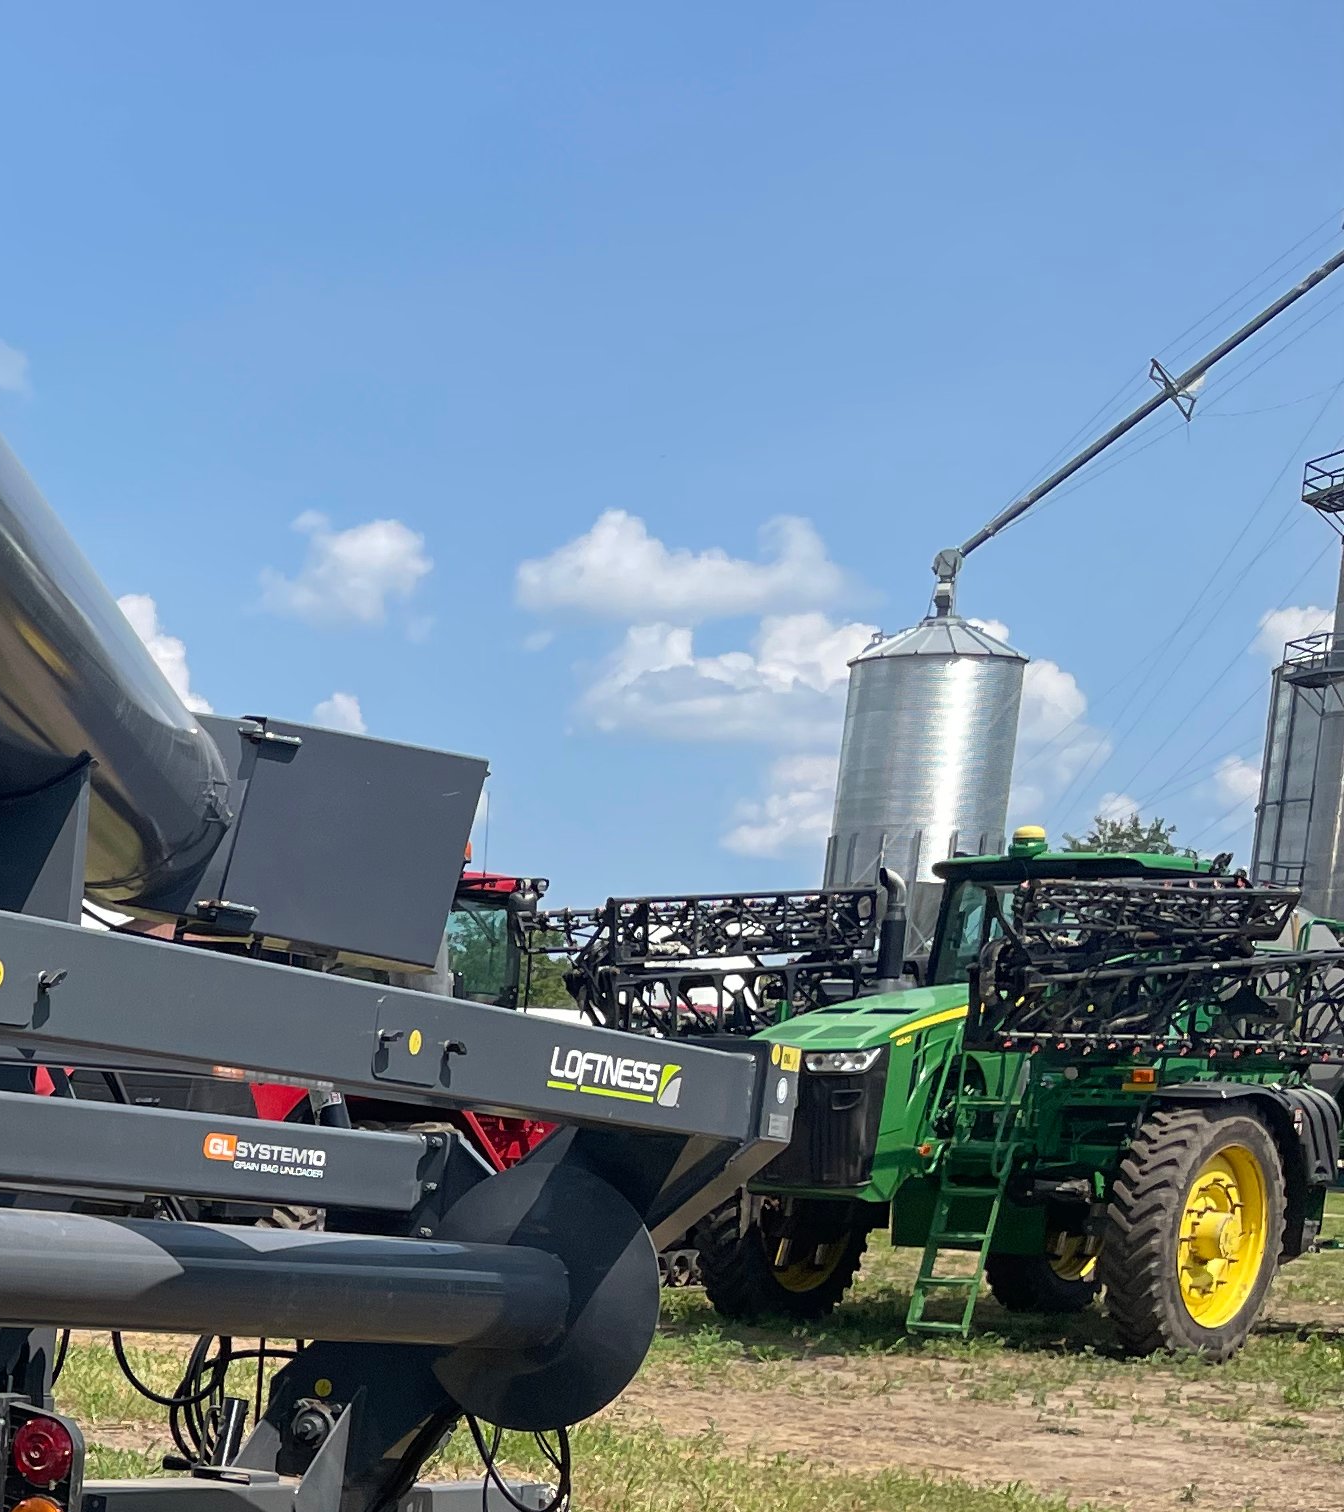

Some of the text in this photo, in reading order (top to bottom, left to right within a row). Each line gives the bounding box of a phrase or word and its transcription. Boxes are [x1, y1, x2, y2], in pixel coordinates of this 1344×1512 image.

[550, 1046, 661, 1092] LOFTNESS
[233, 1160, 324, 1179] GRAIN BAG UNLOADER
